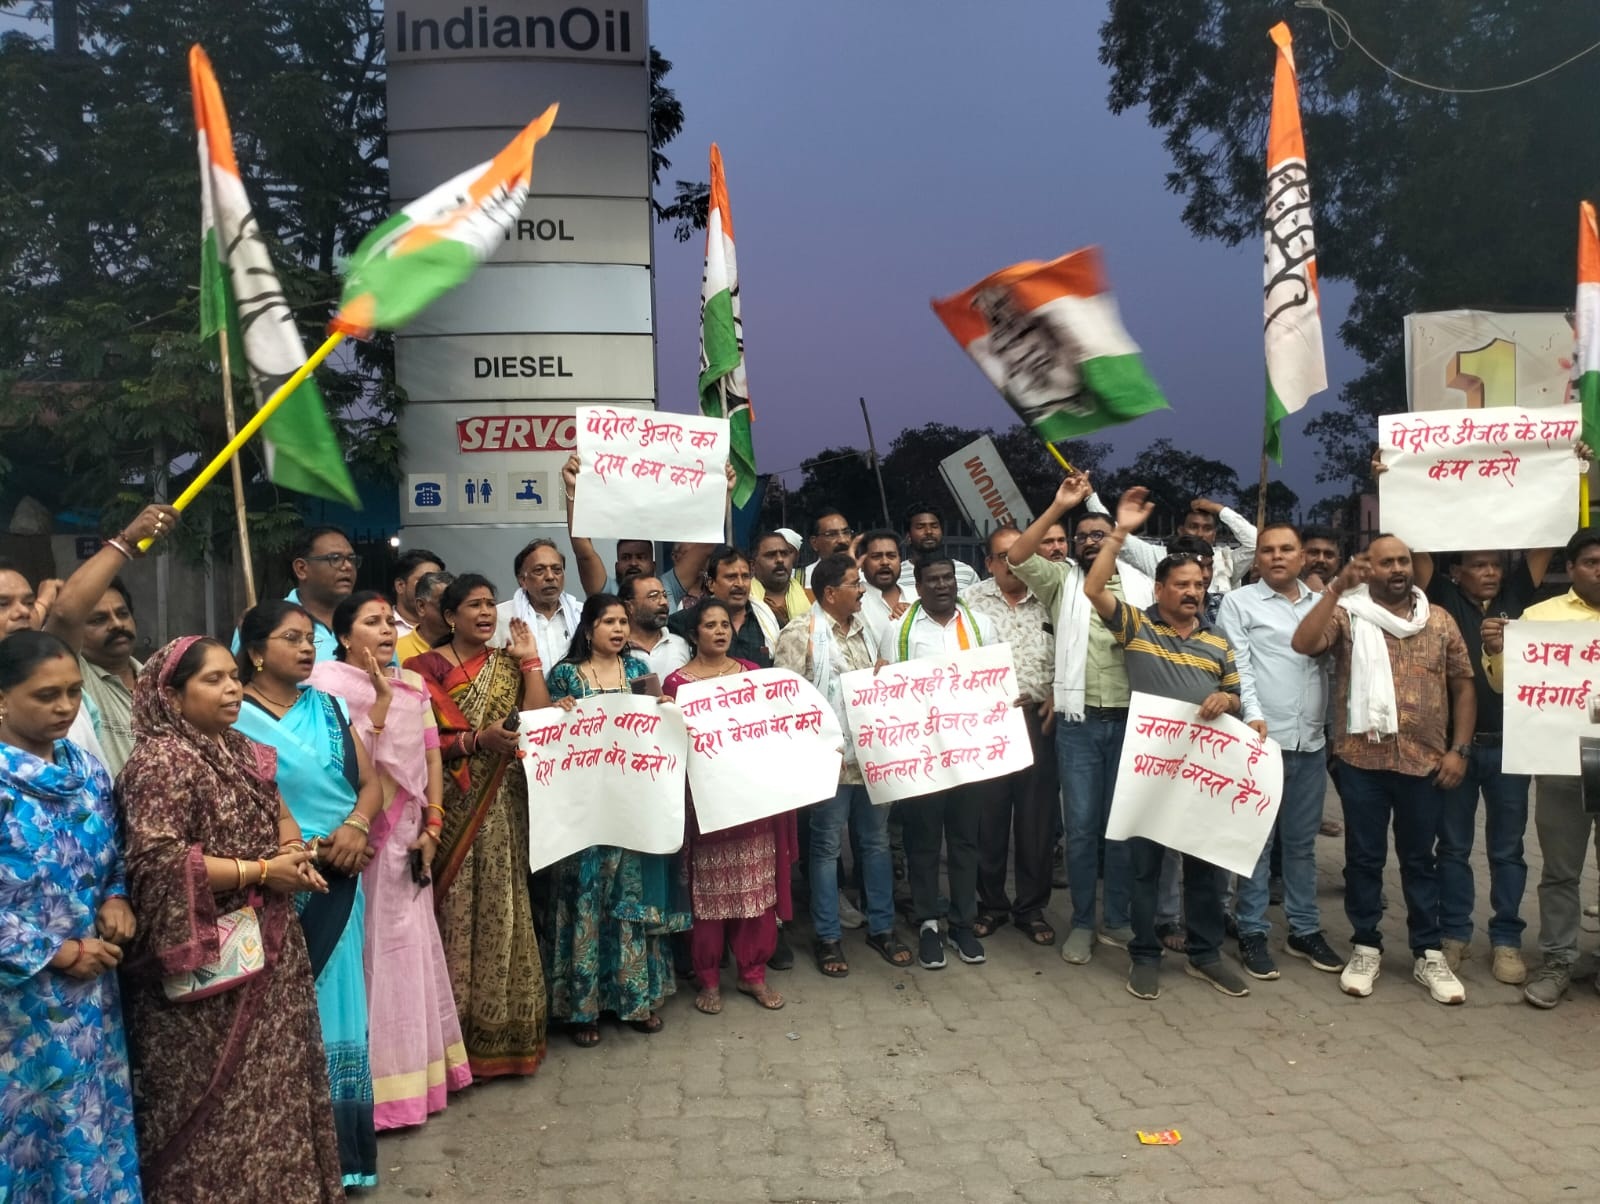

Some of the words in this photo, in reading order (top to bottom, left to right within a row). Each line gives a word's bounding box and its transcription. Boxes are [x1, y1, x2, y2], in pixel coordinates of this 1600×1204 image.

[397, 7, 631, 52] IndianOil
[474, 356, 573, 378] DIESEL
[461, 418, 577, 450] SERVO
[638, 418, 684, 453] डीजल
[689, 430, 718, 449] का
[1390, 418, 1451, 454] पेट्रोल
[1453, 418, 1509, 446] डीजल
[1514, 415, 1537, 441] के
[1541, 420, 1579, 448] दाम
[594, 451, 628, 485] दाम
[632, 457, 666, 484] कम
[670, 459, 706, 494] करो
[1428, 459, 1473, 482] कम
[1477, 450, 1521, 487] करो
[1523, 642, 1574, 667] अब
[762, 679, 800, 704] वाला
[948, 663, 962, 698] है
[963, 666, 1011, 696] कतार
[526, 722, 566, 746] चाय
[569, 708, 608, 737] बेचने
[613, 712, 661, 737] वाला
[687, 727, 723, 759] देश
[795, 704, 823, 734] करो
[858, 725, 873, 749] में
[923, 706, 979, 737] डीजल
[983, 701, 1008, 726] की
[1136, 714, 1187, 744] जनता
[532, 752, 556, 785] देश
[561, 744, 603, 771] बेचना
[604, 741, 627, 774] बंद
[920, 745, 938, 783] है
[940, 747, 984, 770] बजार
[987, 735, 1010, 761] में
[1182, 762, 1233, 798] मस्त
